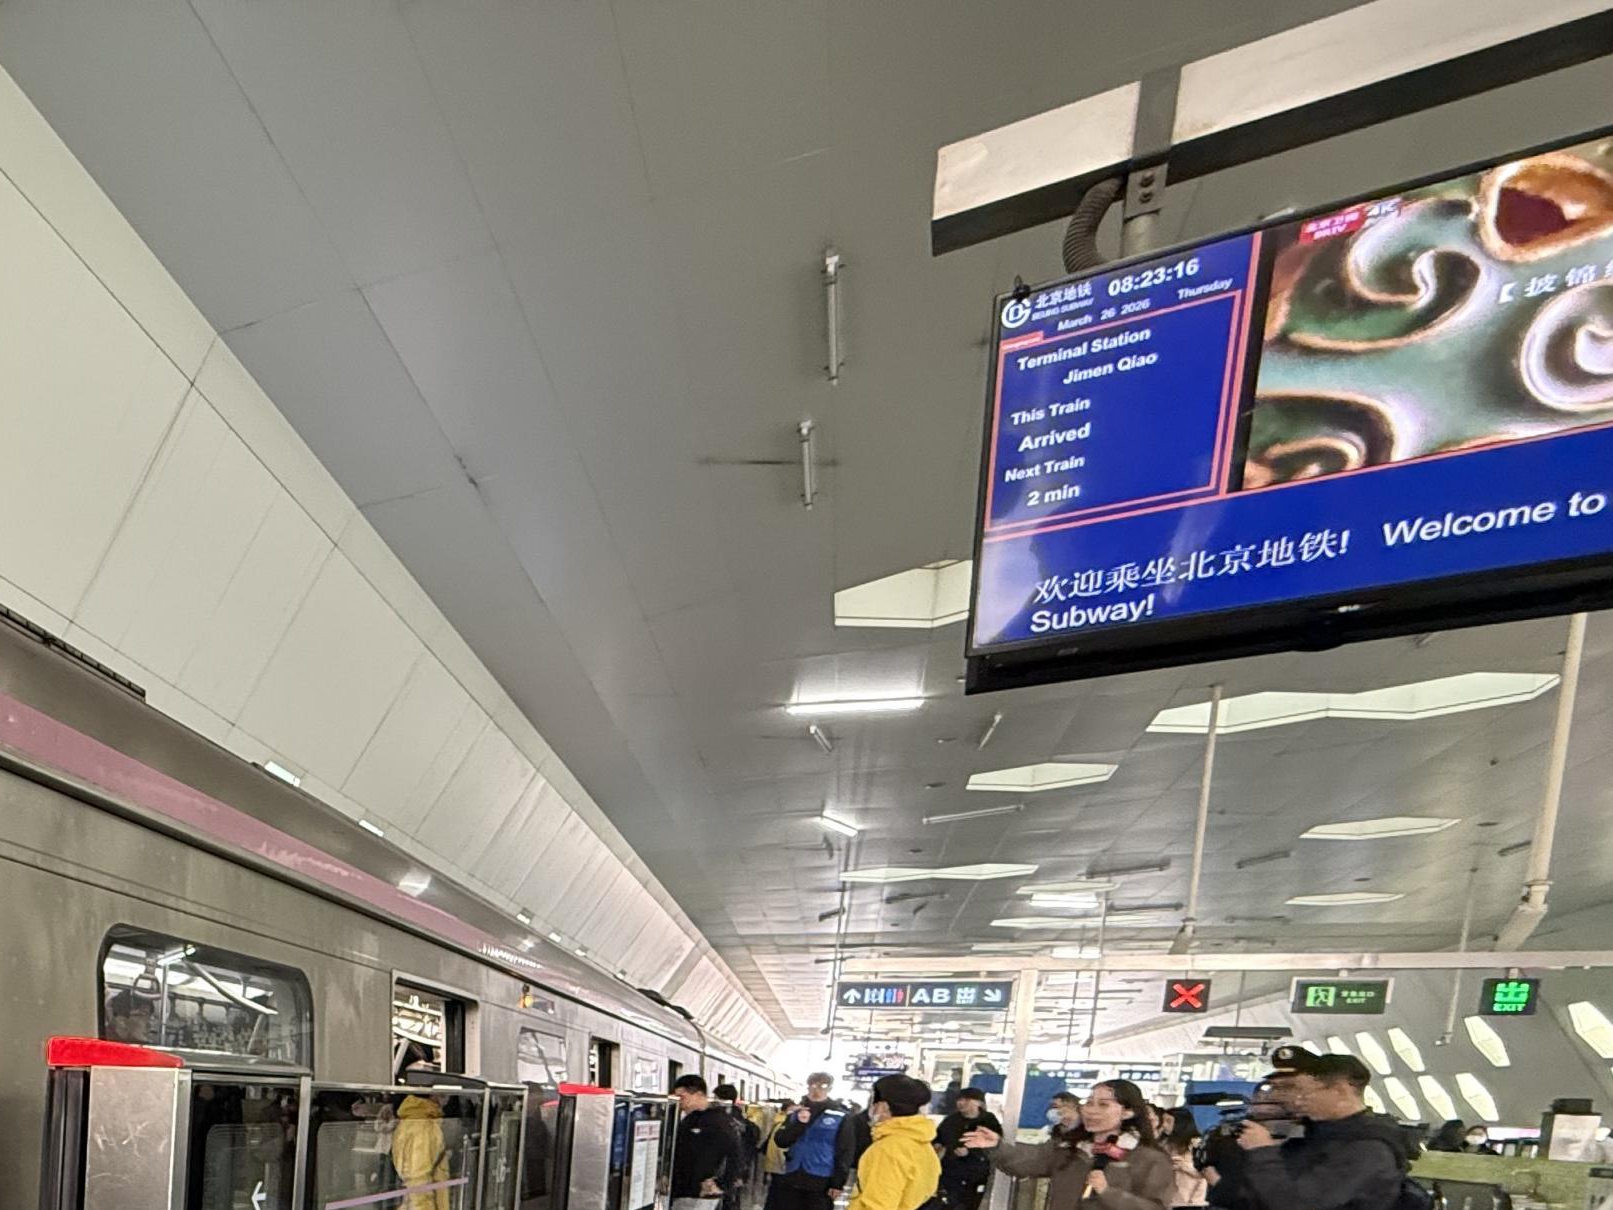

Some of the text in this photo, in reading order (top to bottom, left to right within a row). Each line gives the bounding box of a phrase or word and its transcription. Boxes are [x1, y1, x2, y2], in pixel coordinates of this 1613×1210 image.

[1107, 258, 1200, 296] 08:23:16
[1035, 282, 1092, 309] 北京地铁
[1057, 278, 1233, 332] March 26 2026 Thursday
[1017, 329, 1151, 371] Terminal Station
[1063, 352, 1159, 385] Jimen Qiao
[1010, 398, 1091, 425] This Train
[1018, 422, 1091, 452] Arrived
[1004, 455, 1086, 482] Next Train
[1027, 484, 1081, 507] 2 min
[1033, 491, 1607, 605] 欢迎乘坐北京地铁! Welcome to
[1030, 593, 1155, 633] Subway!
[911, 987, 951, 1004] AB
[1492, 1002, 1527, 1012] EXIT
